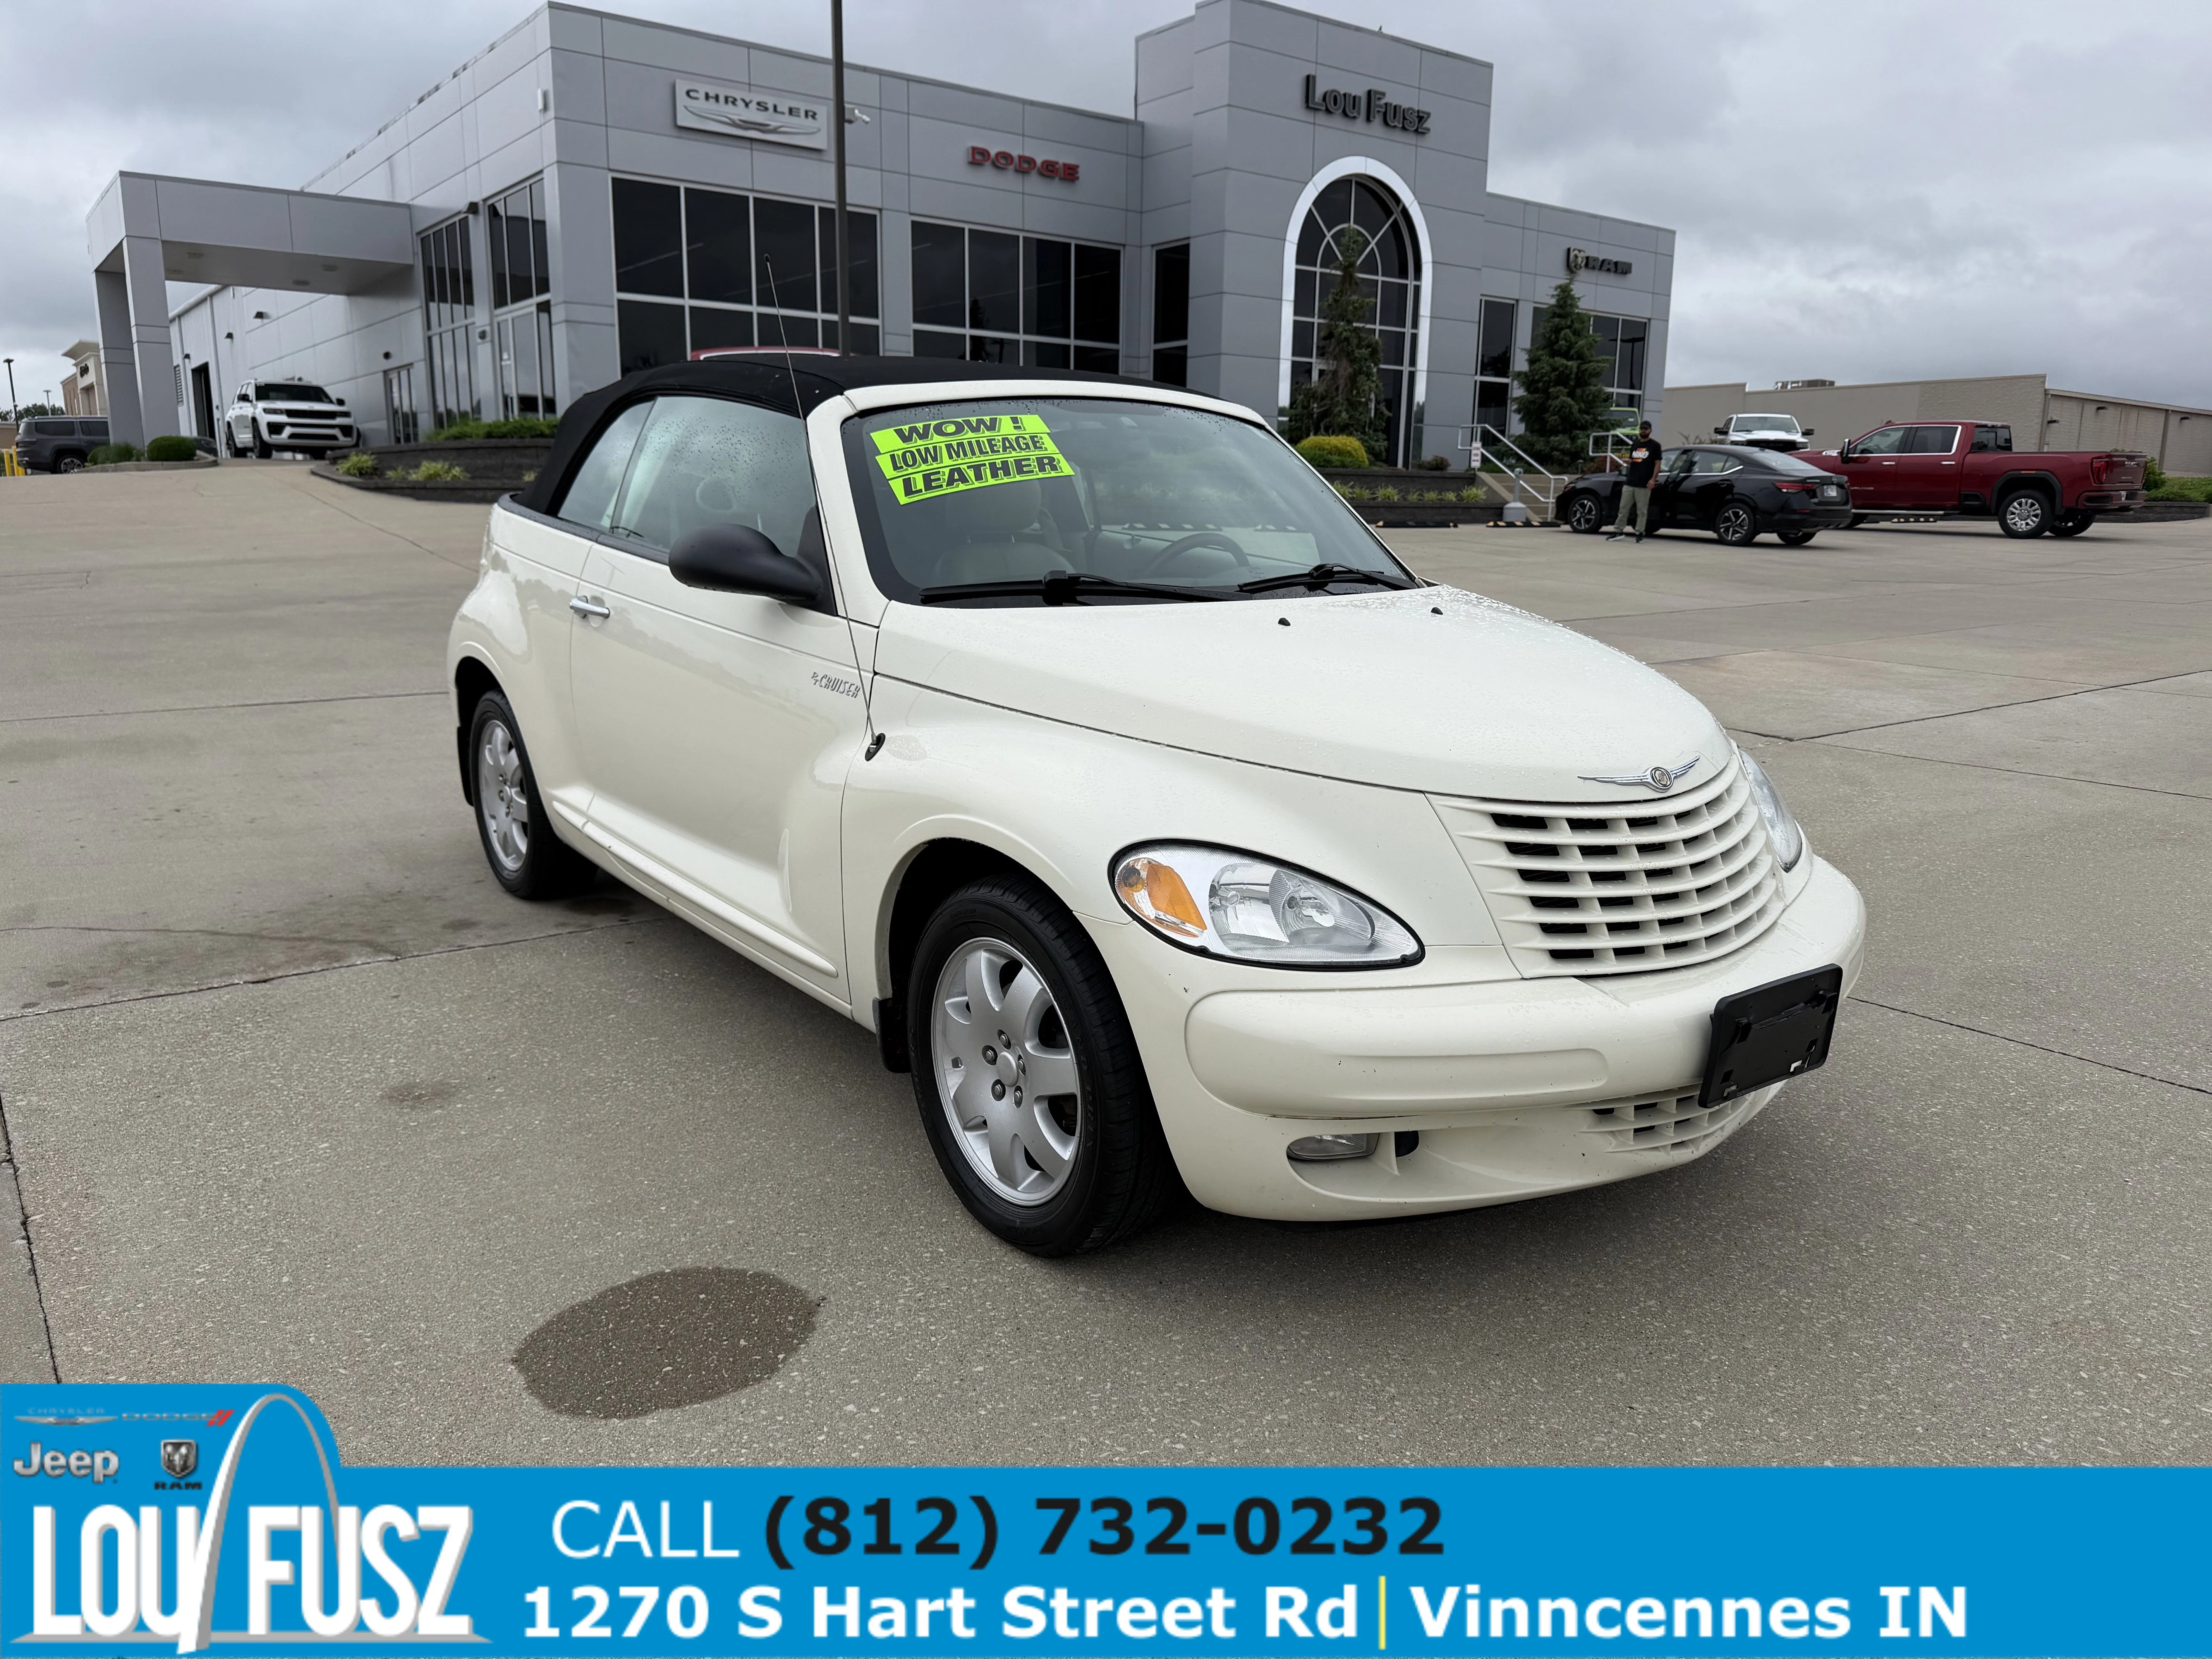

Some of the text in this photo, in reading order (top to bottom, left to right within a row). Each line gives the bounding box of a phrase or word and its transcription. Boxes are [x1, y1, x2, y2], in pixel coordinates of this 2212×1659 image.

[685, 88, 818, 120] CHRYSLER
[1305, 74, 1431, 134] Lou Fusz
[969, 146, 1080, 180] DODGE
[1585, 255, 1632, 275] RAM
[893, 417, 1002, 445] WOW
[890, 435, 1048, 472] LOW MILEAGE
[902, 456, 1064, 498] LEATHER
[819, 674, 860, 698] CRUISER
